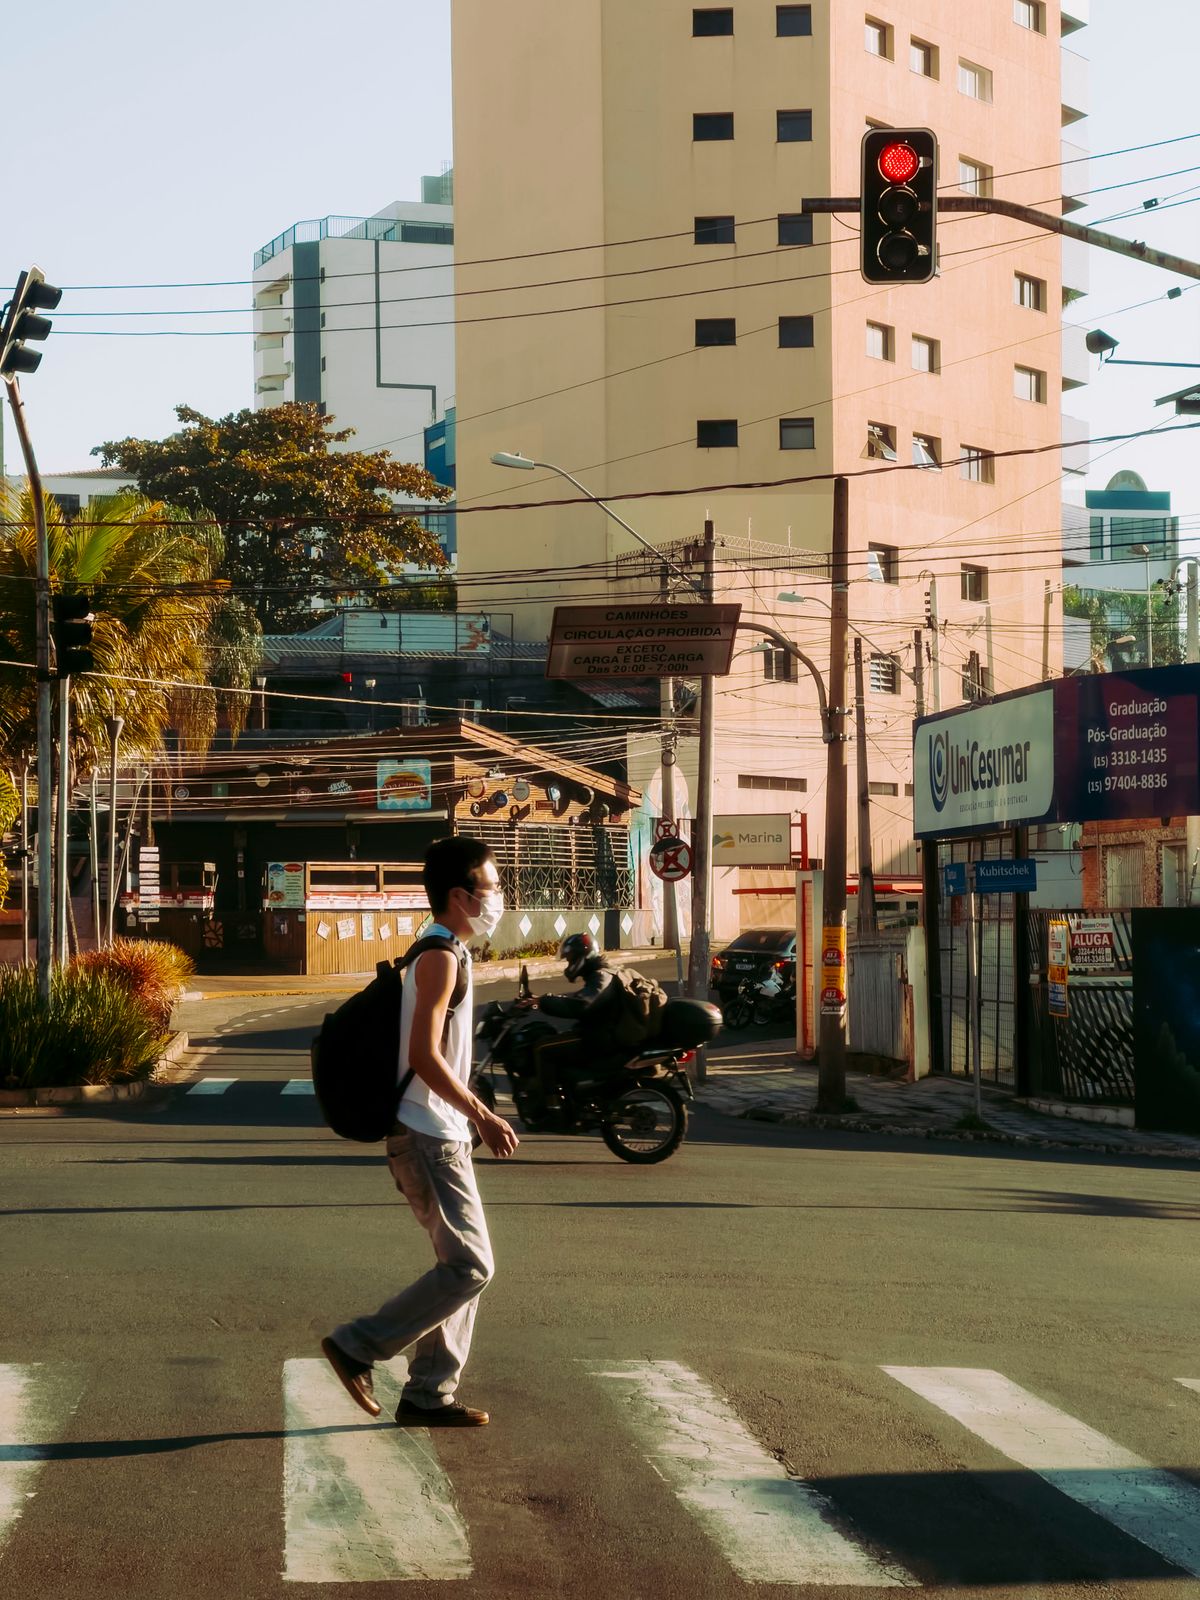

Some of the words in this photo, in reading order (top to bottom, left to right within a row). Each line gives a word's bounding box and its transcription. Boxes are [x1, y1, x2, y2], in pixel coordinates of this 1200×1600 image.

[606, 608, 689, 621] CAMINHÕES
[563, 627, 655, 641] CIRCULAÇÃO
[657, 626, 722, 637] PROIBIDA
[616, 644, 666, 654] EXCETO
[573, 655, 619, 665] CARGA
[623, 655, 631, 664] E
[634, 653, 704, 664] DESCARGA
[587, 665, 610, 674] Das
[613, 664, 645, 673] 20:00
[656, 663, 689, 672] 7:00h
[1109, 697, 1168, 717] Graduação
[1087, 722, 1168, 743] Pós-Graduação
[1093, 755, 1109, 769] (15)
[1110, 748, 1168, 766] 3318-1435
[950, 739, 1031, 796] UniCesumar
[1087, 780, 1103, 794] (15)
[1104, 773, 1168, 791] 97404-8836
[738, 832, 783, 843] Marina
[980, 865, 1030, 877] Kubitschek
[1074, 933, 1110, 946] ALUGA
